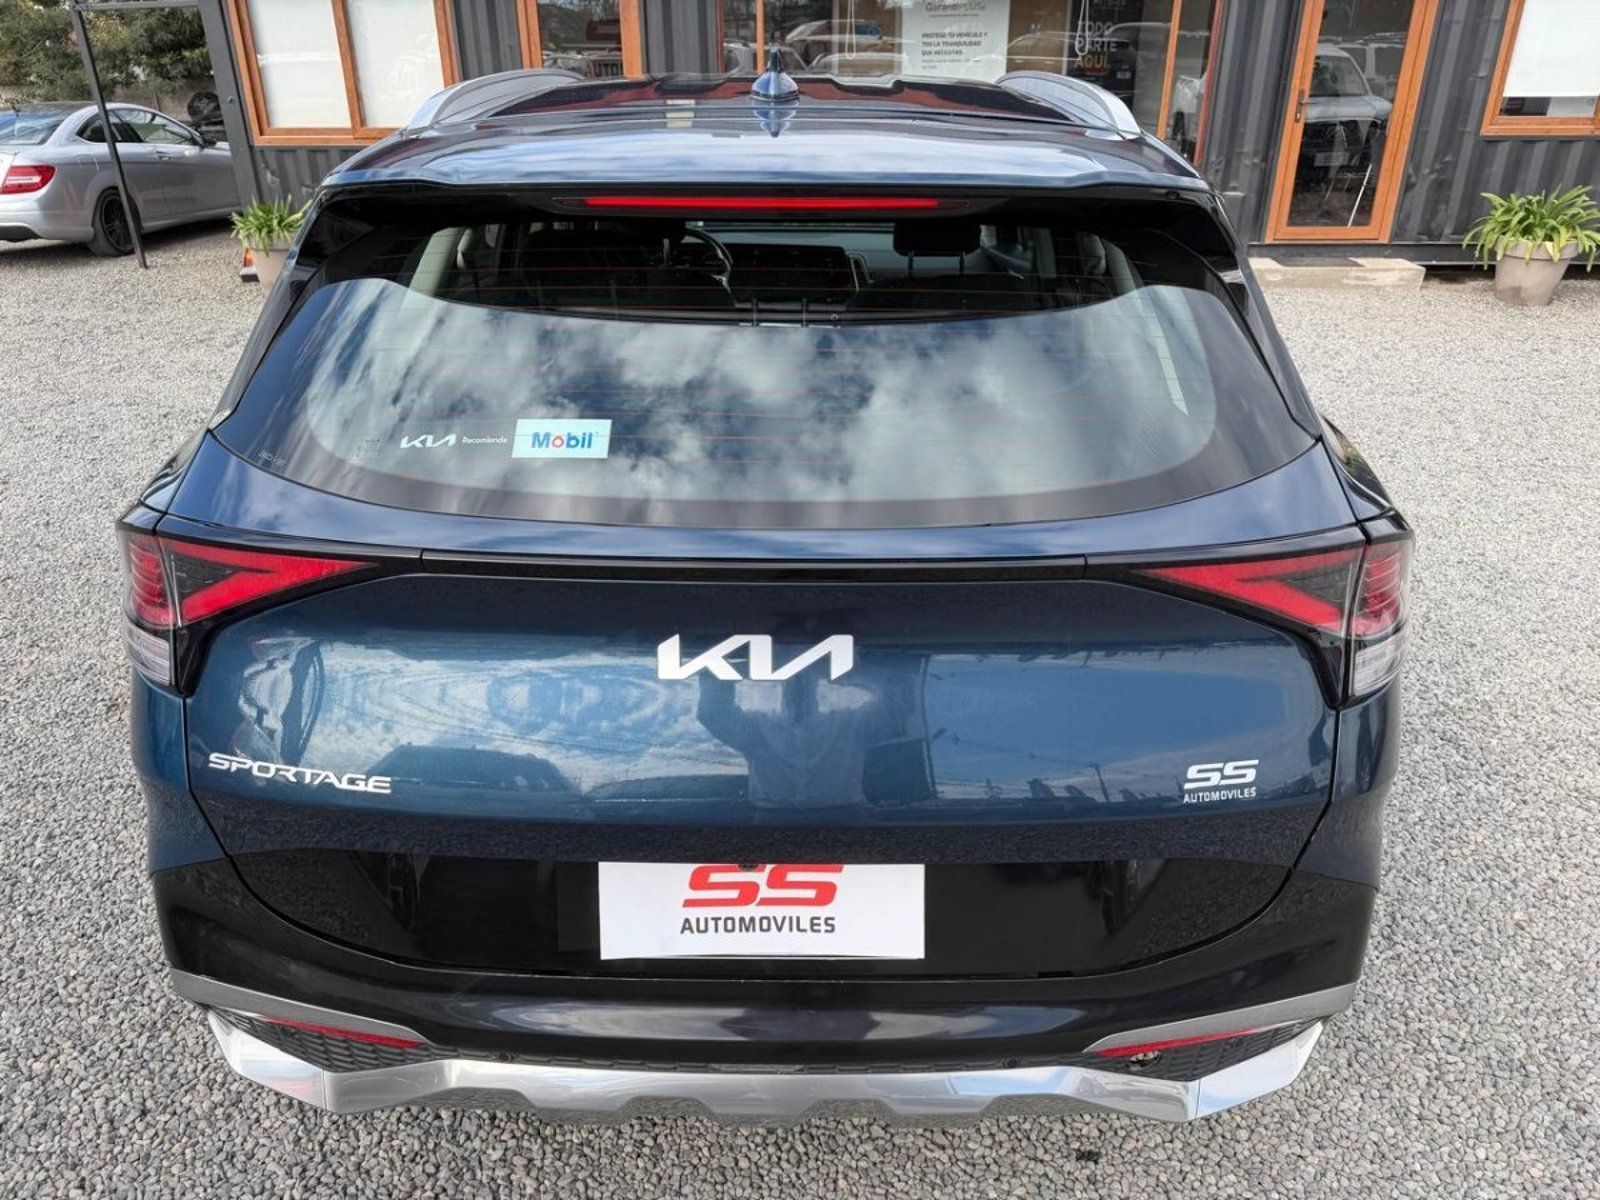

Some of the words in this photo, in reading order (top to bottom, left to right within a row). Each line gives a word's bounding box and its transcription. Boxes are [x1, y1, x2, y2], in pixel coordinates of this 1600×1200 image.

[1077, 37, 1117, 52] PARTE
[400, 433, 457, 449] KIA
[531, 431, 594, 449] Mobil
[657, 633, 854, 680] KIA
[208, 752, 392, 794] SPORTAGE
[1184, 759, 1260, 790] SS
[1183, 786, 1257, 804] AUTOMOVILES
[682, 863, 845, 908] SS
[680, 915, 836, 934] AUTOMOVILES
